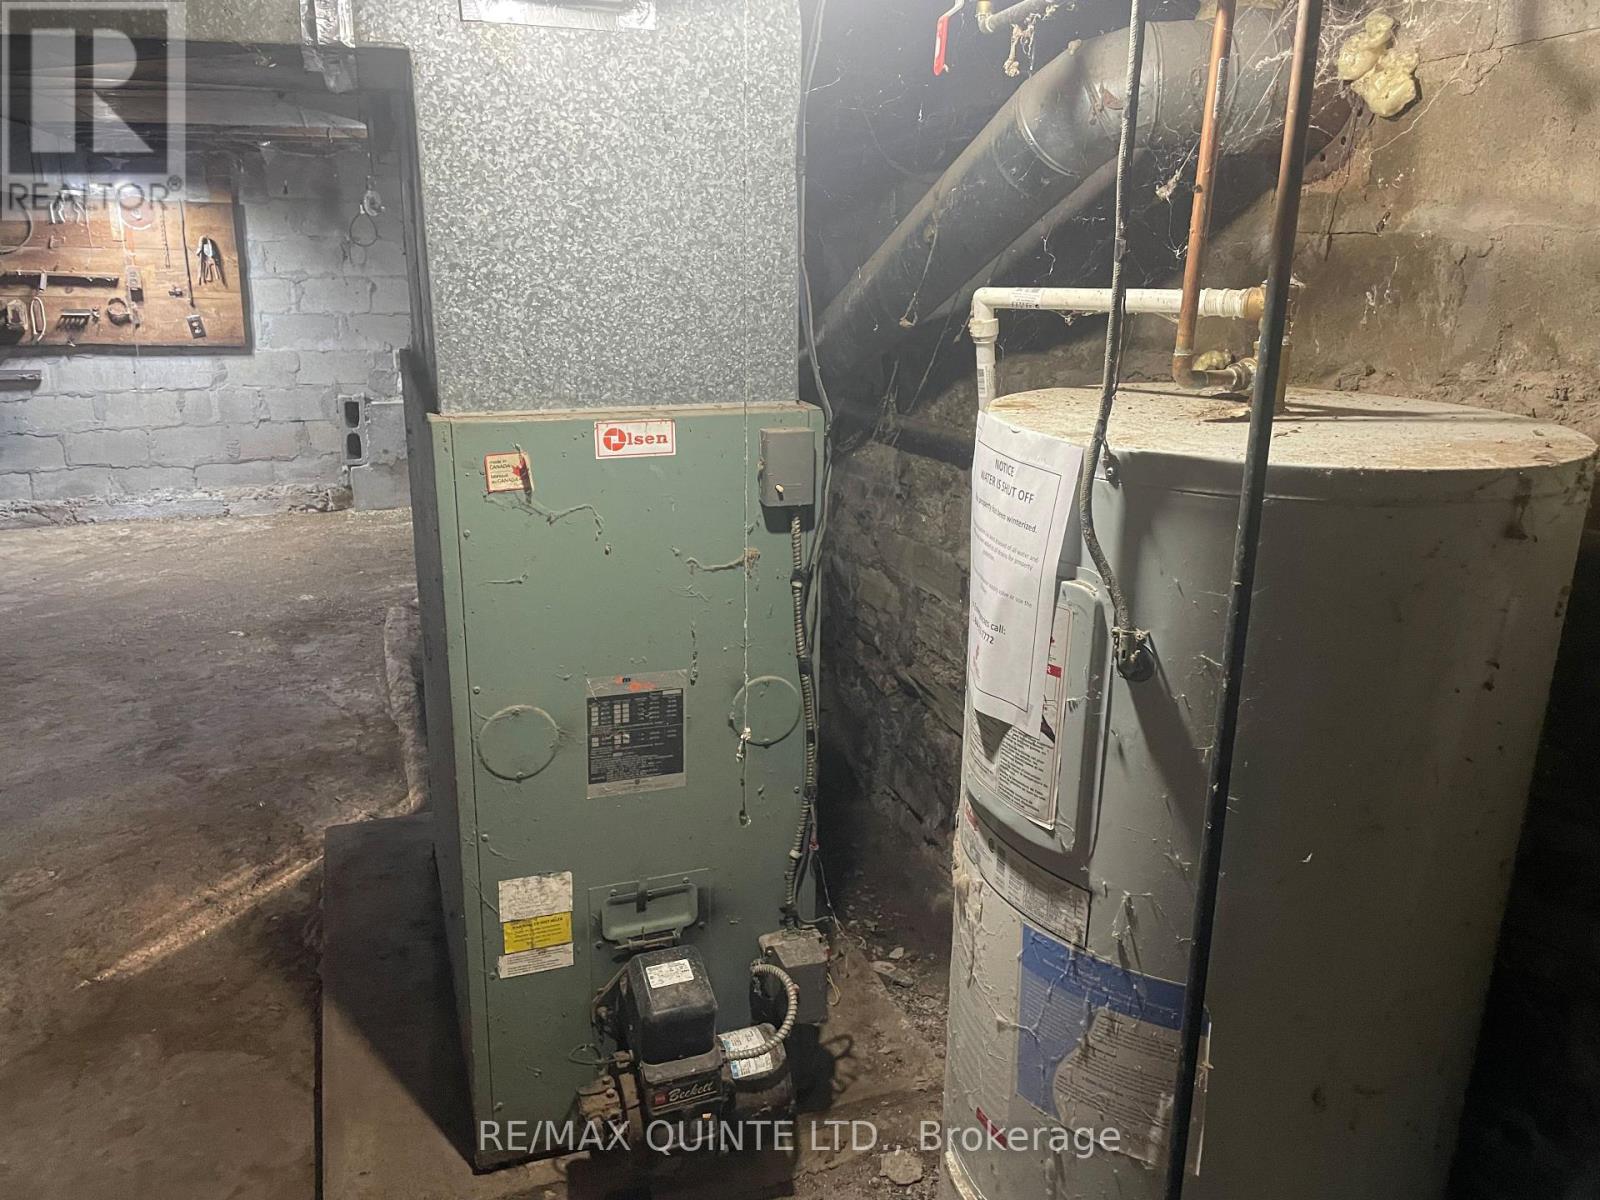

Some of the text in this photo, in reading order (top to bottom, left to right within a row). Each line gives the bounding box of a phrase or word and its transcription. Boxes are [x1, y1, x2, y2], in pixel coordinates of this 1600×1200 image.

[994, 458, 1015, 478] NOTICE
[1001, 481, 1017, 498] SHUT
[1017, 489, 1035, 504] OFF
[990, 623, 1006, 635] call:
